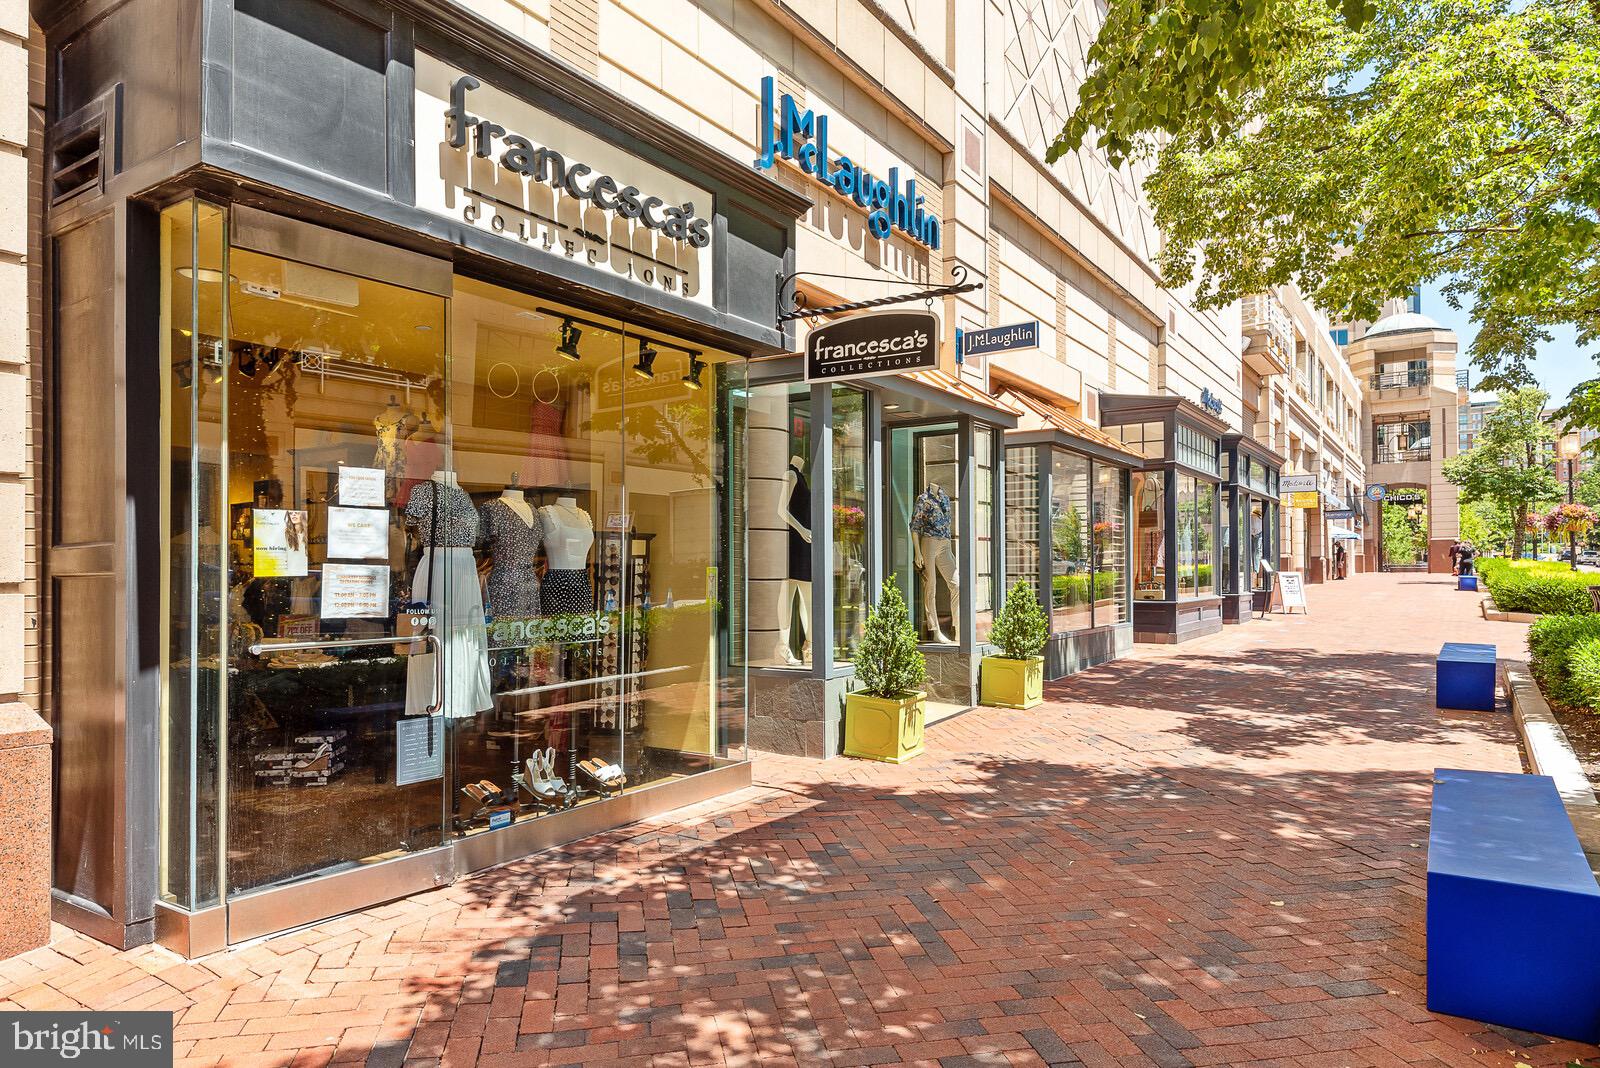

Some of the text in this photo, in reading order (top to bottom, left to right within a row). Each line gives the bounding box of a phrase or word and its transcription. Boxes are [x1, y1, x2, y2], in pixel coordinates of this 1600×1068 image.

[443, 75, 711, 249] francesca's
[814, 329, 929, 361] francesca's
[821, 355, 922, 375] COLLECTIONS
[1383, 492, 1422, 502] CHICO'S
